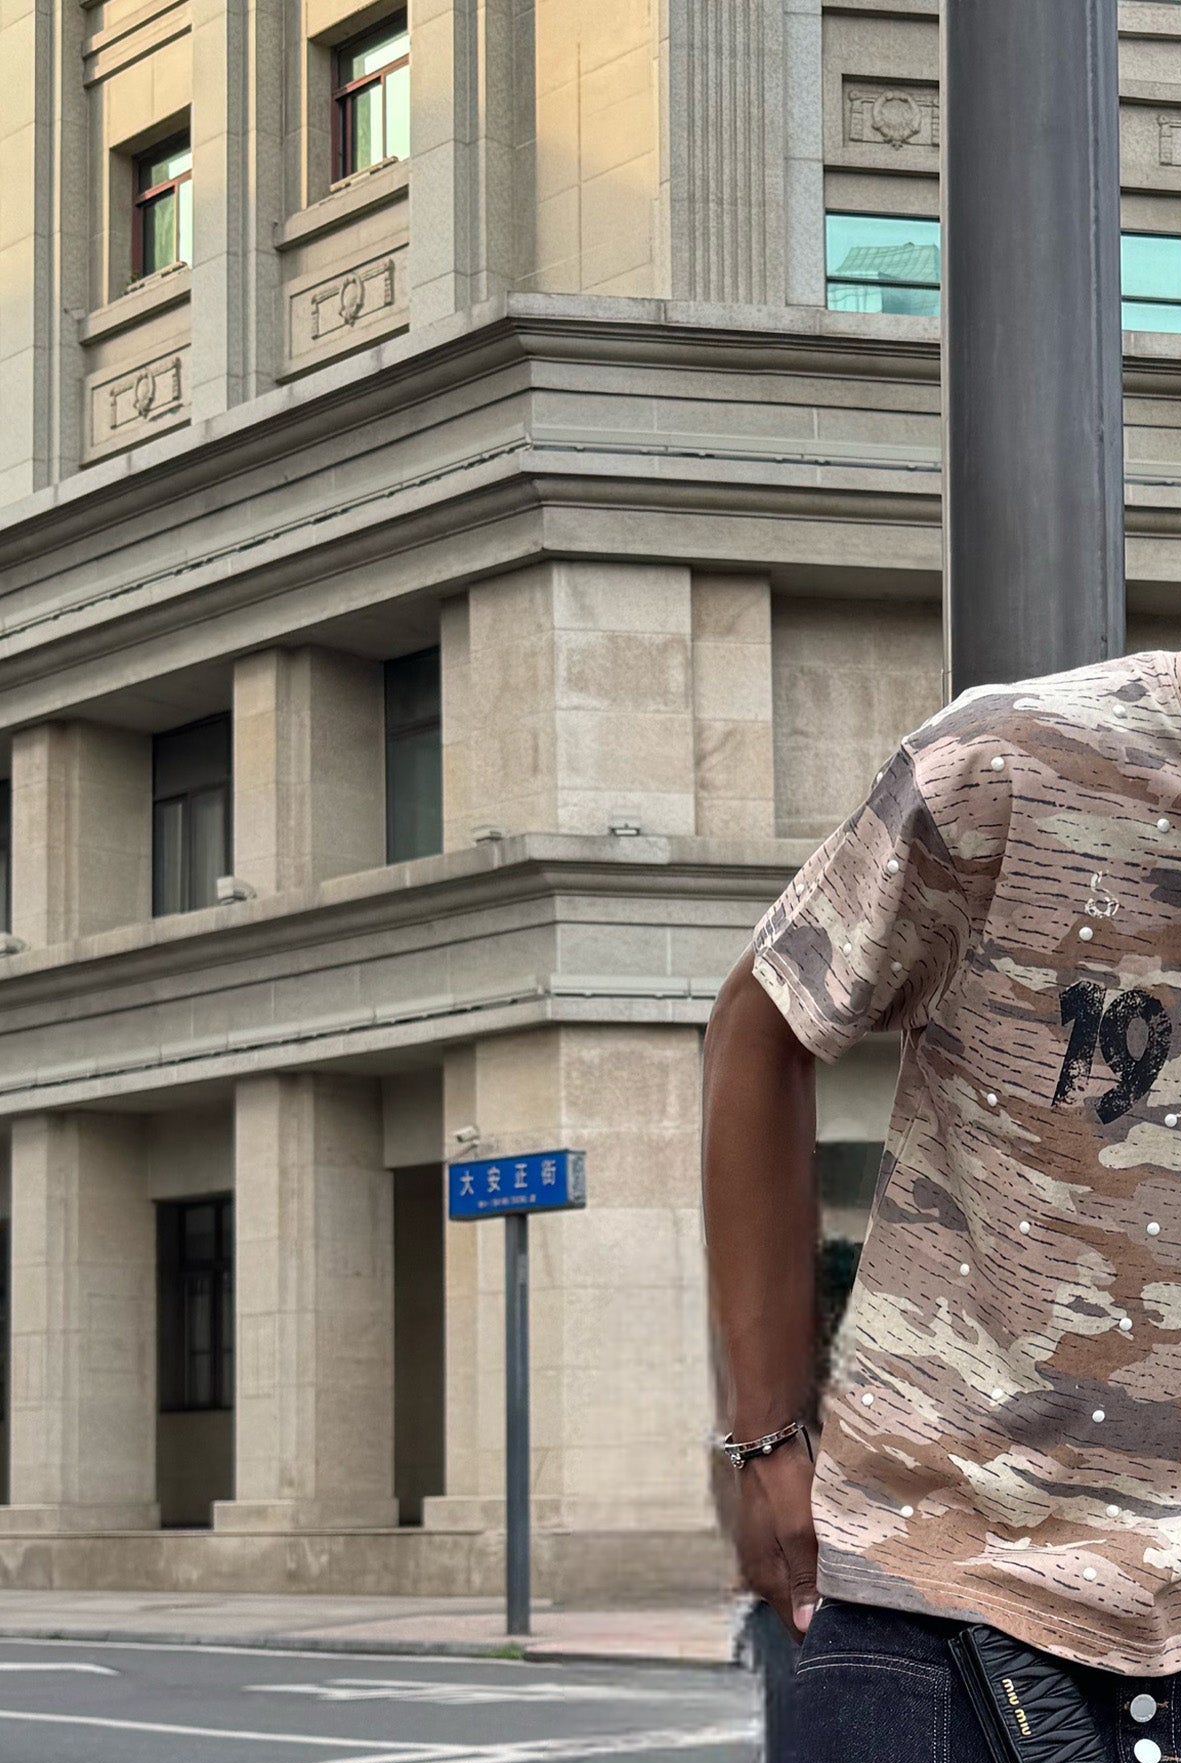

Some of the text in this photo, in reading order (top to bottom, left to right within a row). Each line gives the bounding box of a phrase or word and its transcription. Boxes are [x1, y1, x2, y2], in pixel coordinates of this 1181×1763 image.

[1051, 980, 1173, 1125] 19
[459, 1159, 556, 1197] 大安正街
[1002, 1678, 1032, 1736] miu miu
